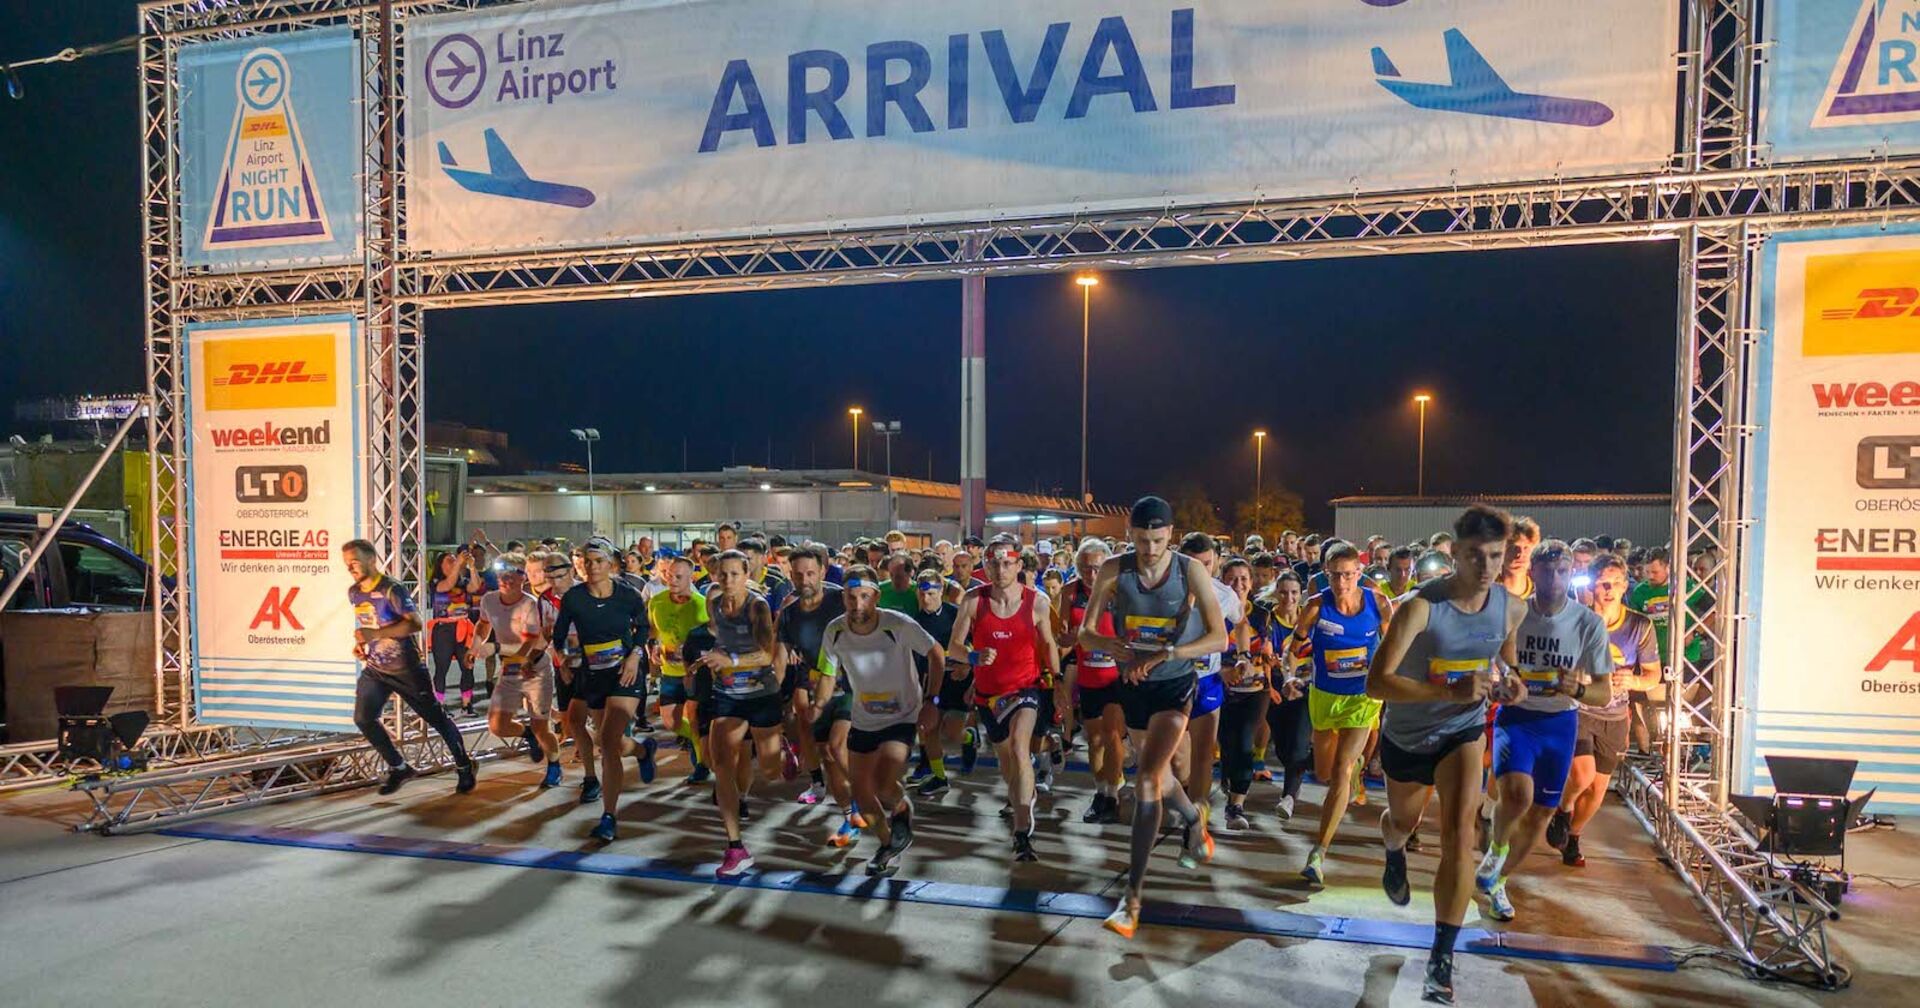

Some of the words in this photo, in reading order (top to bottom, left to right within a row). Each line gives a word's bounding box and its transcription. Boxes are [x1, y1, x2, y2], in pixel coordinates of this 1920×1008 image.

[497, 29, 564, 63] Linz
[497, 66, 616, 104] Airport
[698, 8, 1236, 153] ARRIVAL
[250, 122, 278, 131] DHL
[254, 141, 275, 152] Linz
[246, 152, 283, 167] Airport
[241, 169, 288, 186] NIGHT
[232, 186, 300, 222] RUN
[1853, 288, 1920, 318] D
[228, 361, 311, 385] DHL
[211, 420, 330, 447] weekend
[237, 508, 308, 518] OBERÖSTERREICH
[219, 530, 299, 547] ENERGIE
[302, 529, 329, 547] AG
[303, 551, 328, 559] Service
[221, 562, 238, 573] Wir
[240, 562, 275, 573] denken
[277, 564, 290, 573] an
[292, 564, 330, 576] morgen
[1815, 575, 1849, 589] Wir
[250, 586, 305, 630] AK
[248, 634, 306, 645] Oberösterreich
[1526, 635, 1560, 652] RUN
[1517, 650, 1536, 665] HE
[1542, 652, 1574, 669] SUN
